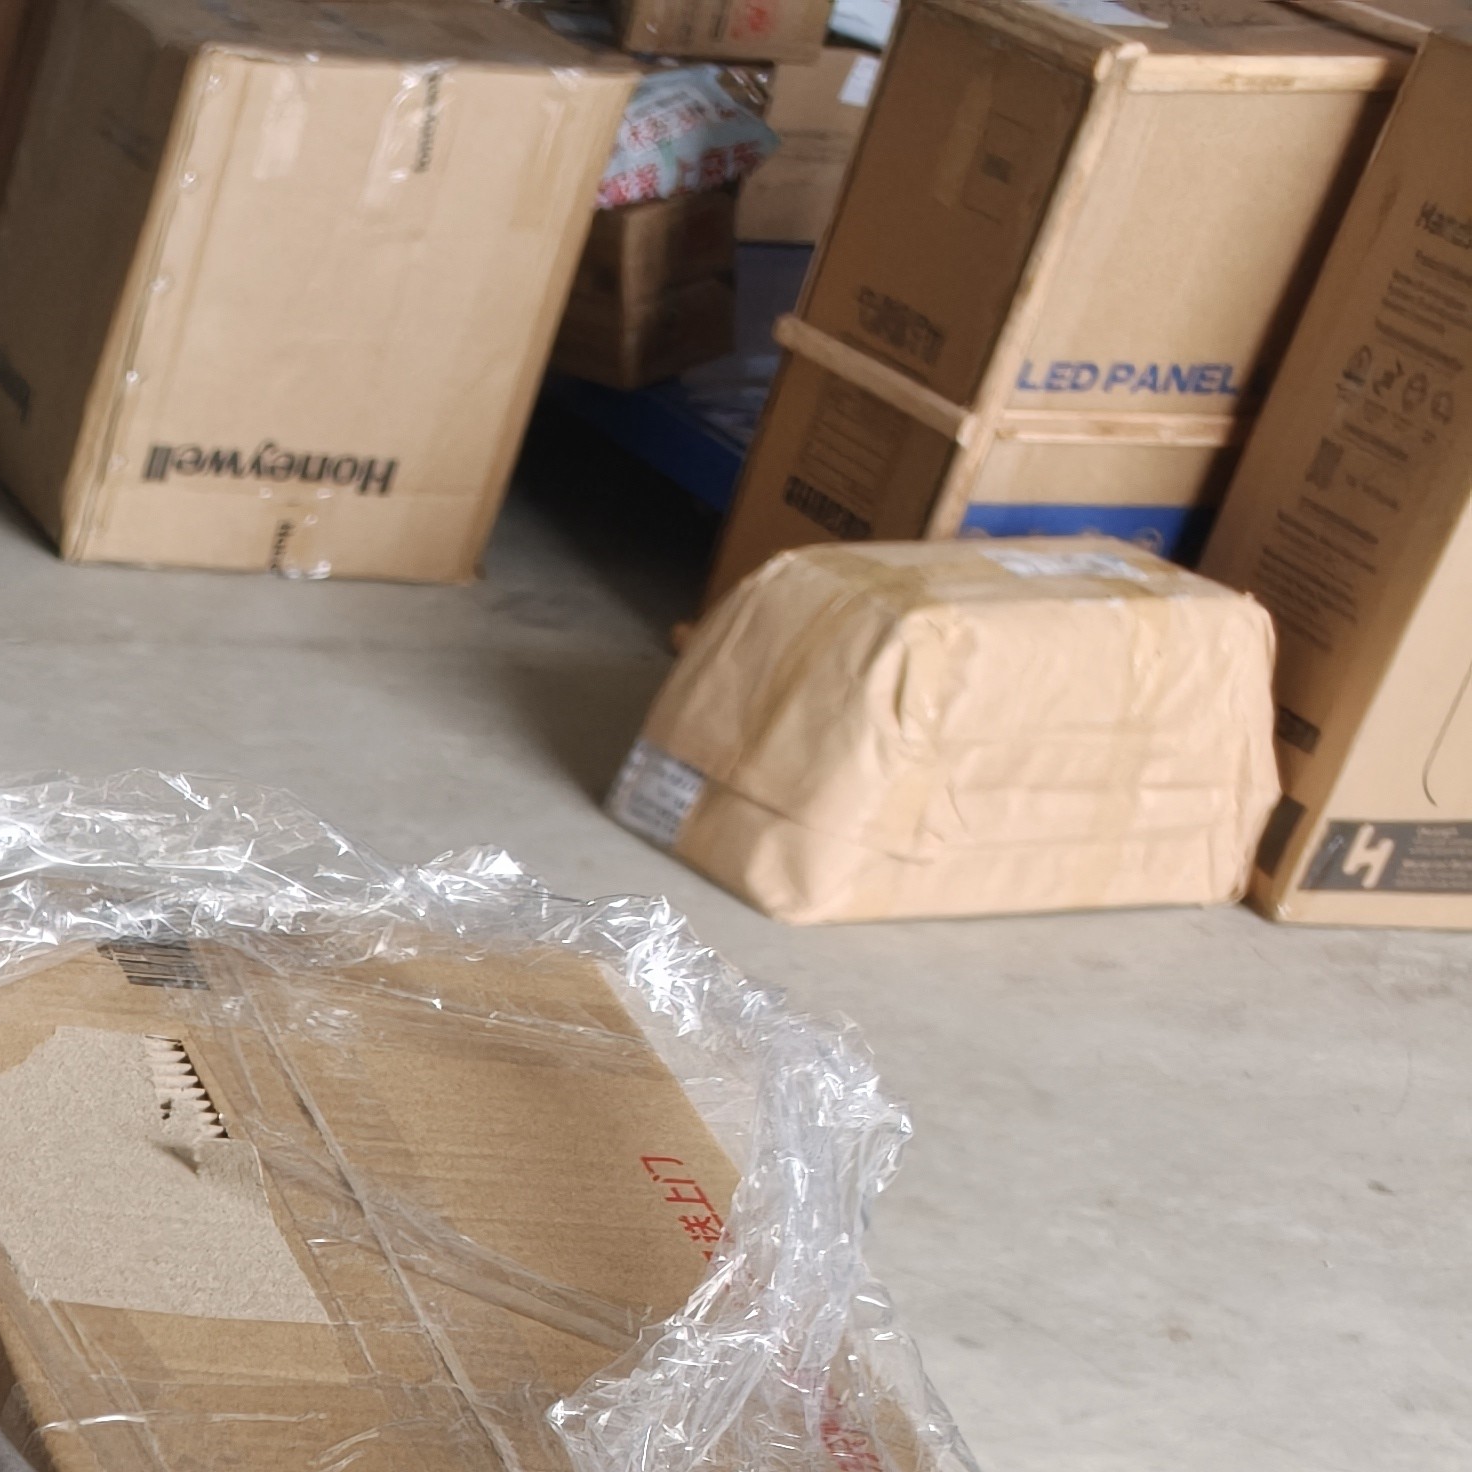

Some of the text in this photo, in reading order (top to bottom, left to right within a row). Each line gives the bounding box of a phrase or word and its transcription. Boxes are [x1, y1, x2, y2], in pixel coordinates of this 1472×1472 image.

[1016, 360, 1240, 396] LED PANEL
[142, 438, 398, 497] Honeywell
[639, 1156, 725, 1262] 送上门
